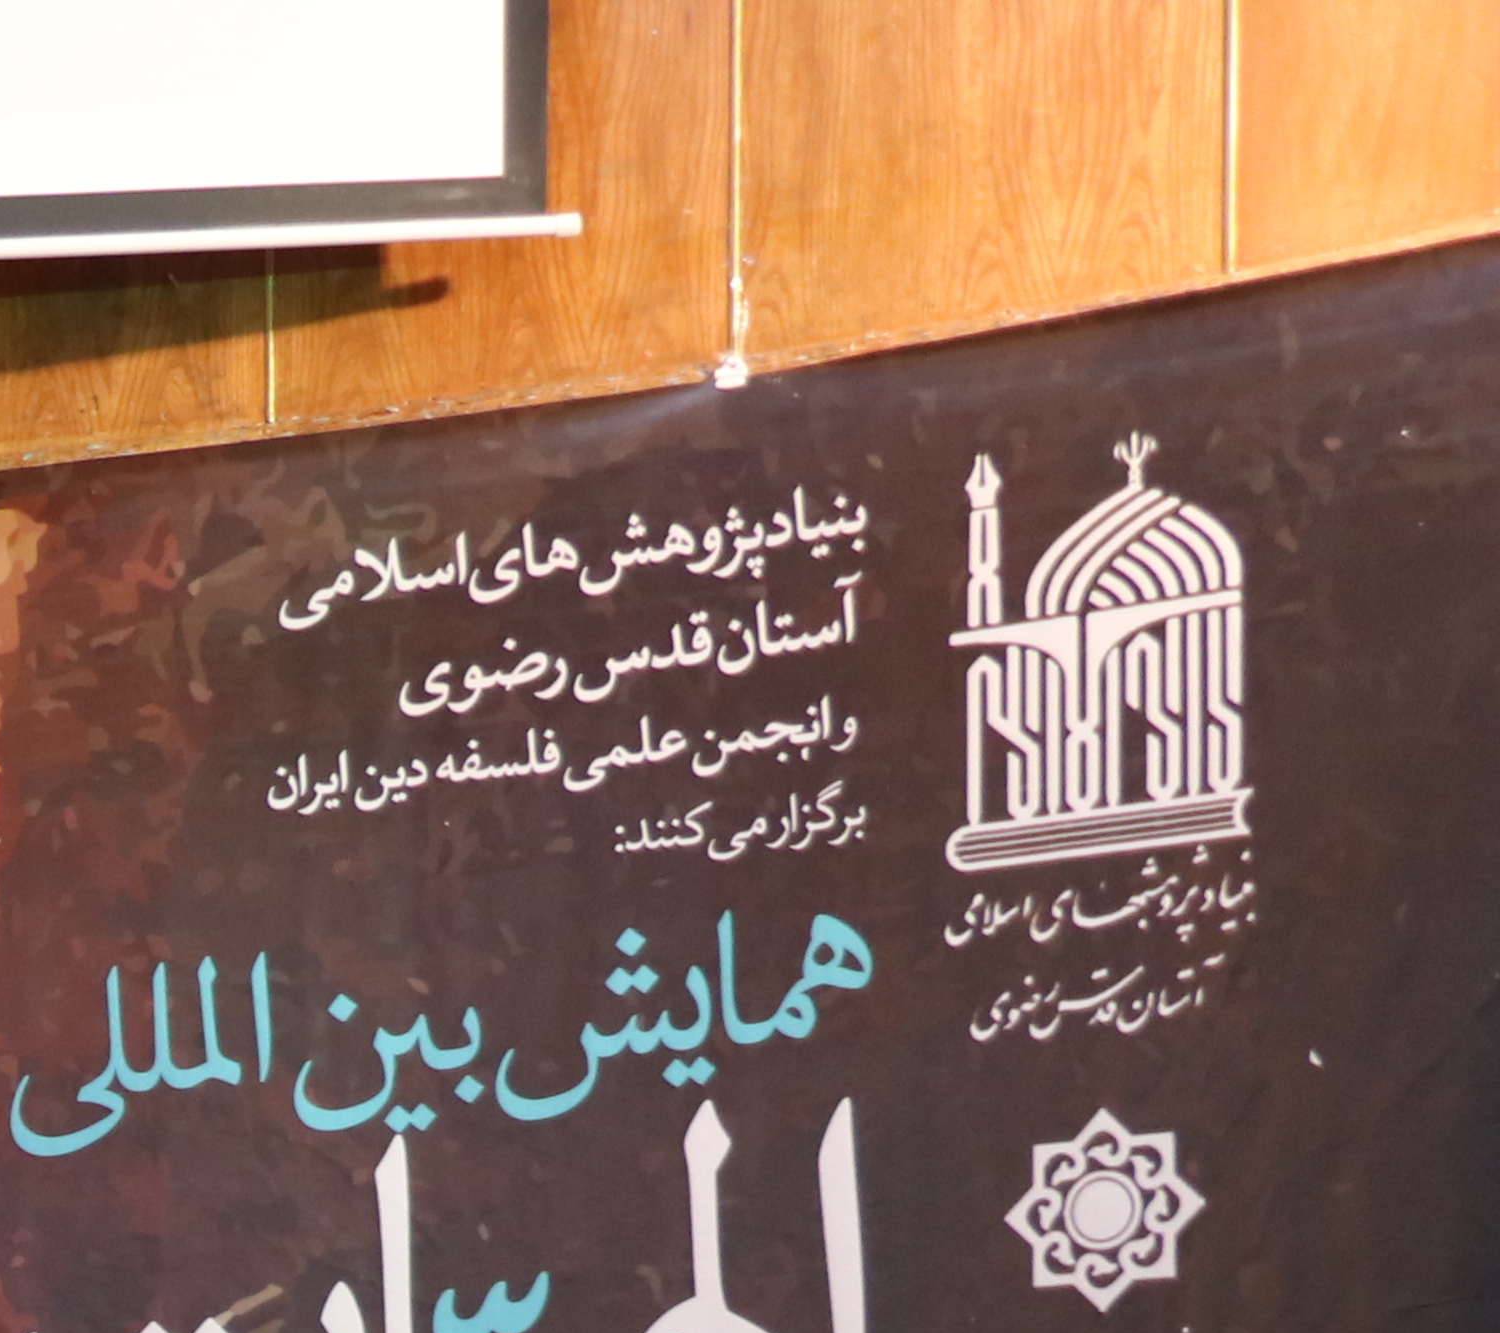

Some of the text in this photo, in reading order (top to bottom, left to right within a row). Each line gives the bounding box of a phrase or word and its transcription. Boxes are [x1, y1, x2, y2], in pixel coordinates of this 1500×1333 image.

[766, 484, 868, 557] بنیاد
[278, 531, 467, 630] اسلامی
[399, 571, 863, 717] آستان قدس رضوی
[434, 728, 562, 783] فلسفه
[563, 715, 687, 792] علمی
[692, 694, 831, 776] انجمن
[266, 749, 349, 815] ایران
[353, 756, 428, 811] دین
[770, 779, 868, 850] برگزار
[943, 892, 1032, 947] اسلامی
[8, 908, 875, 1159] همایش بین المللی
